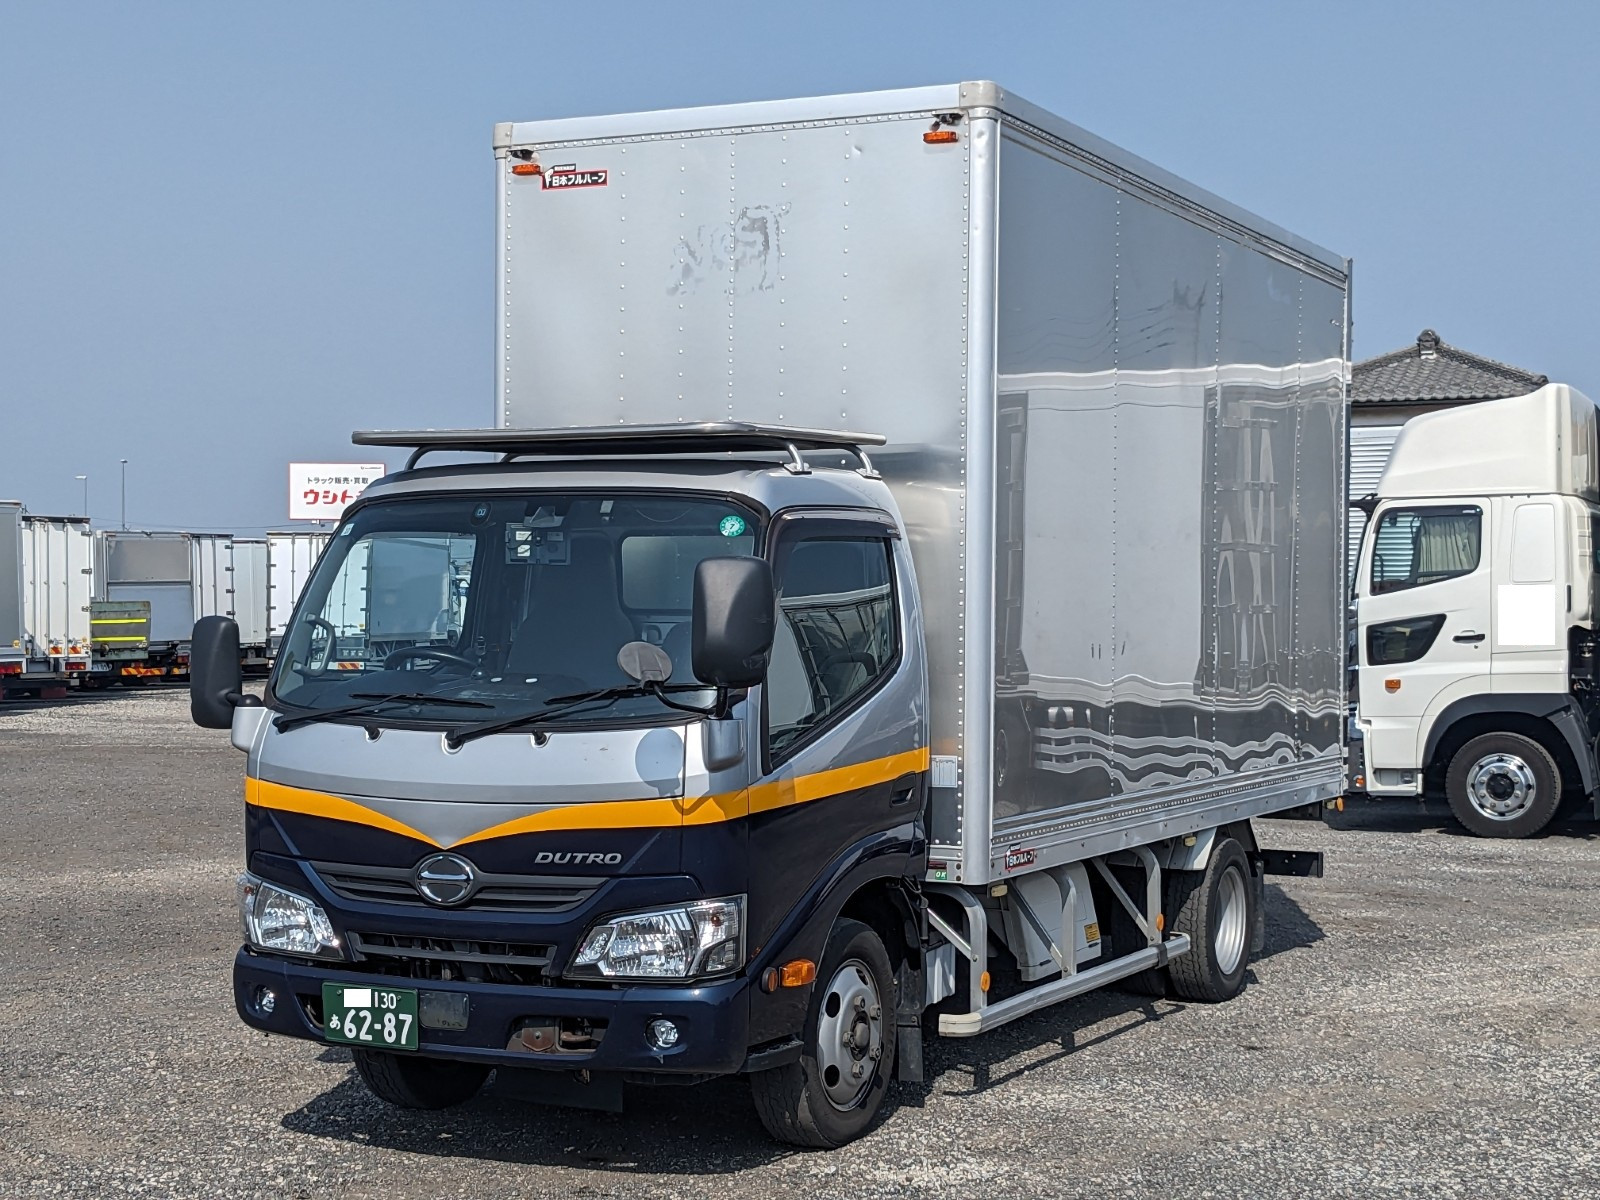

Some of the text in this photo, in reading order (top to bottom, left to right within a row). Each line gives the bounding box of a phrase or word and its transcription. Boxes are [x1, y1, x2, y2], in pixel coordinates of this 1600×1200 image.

[552, 172, 606, 187] 日本フルハーフ
[534, 852, 622, 865] DUTRO
[374, 991, 397, 1009] 130
[329, 1008, 413, 1045] あ 62-87
